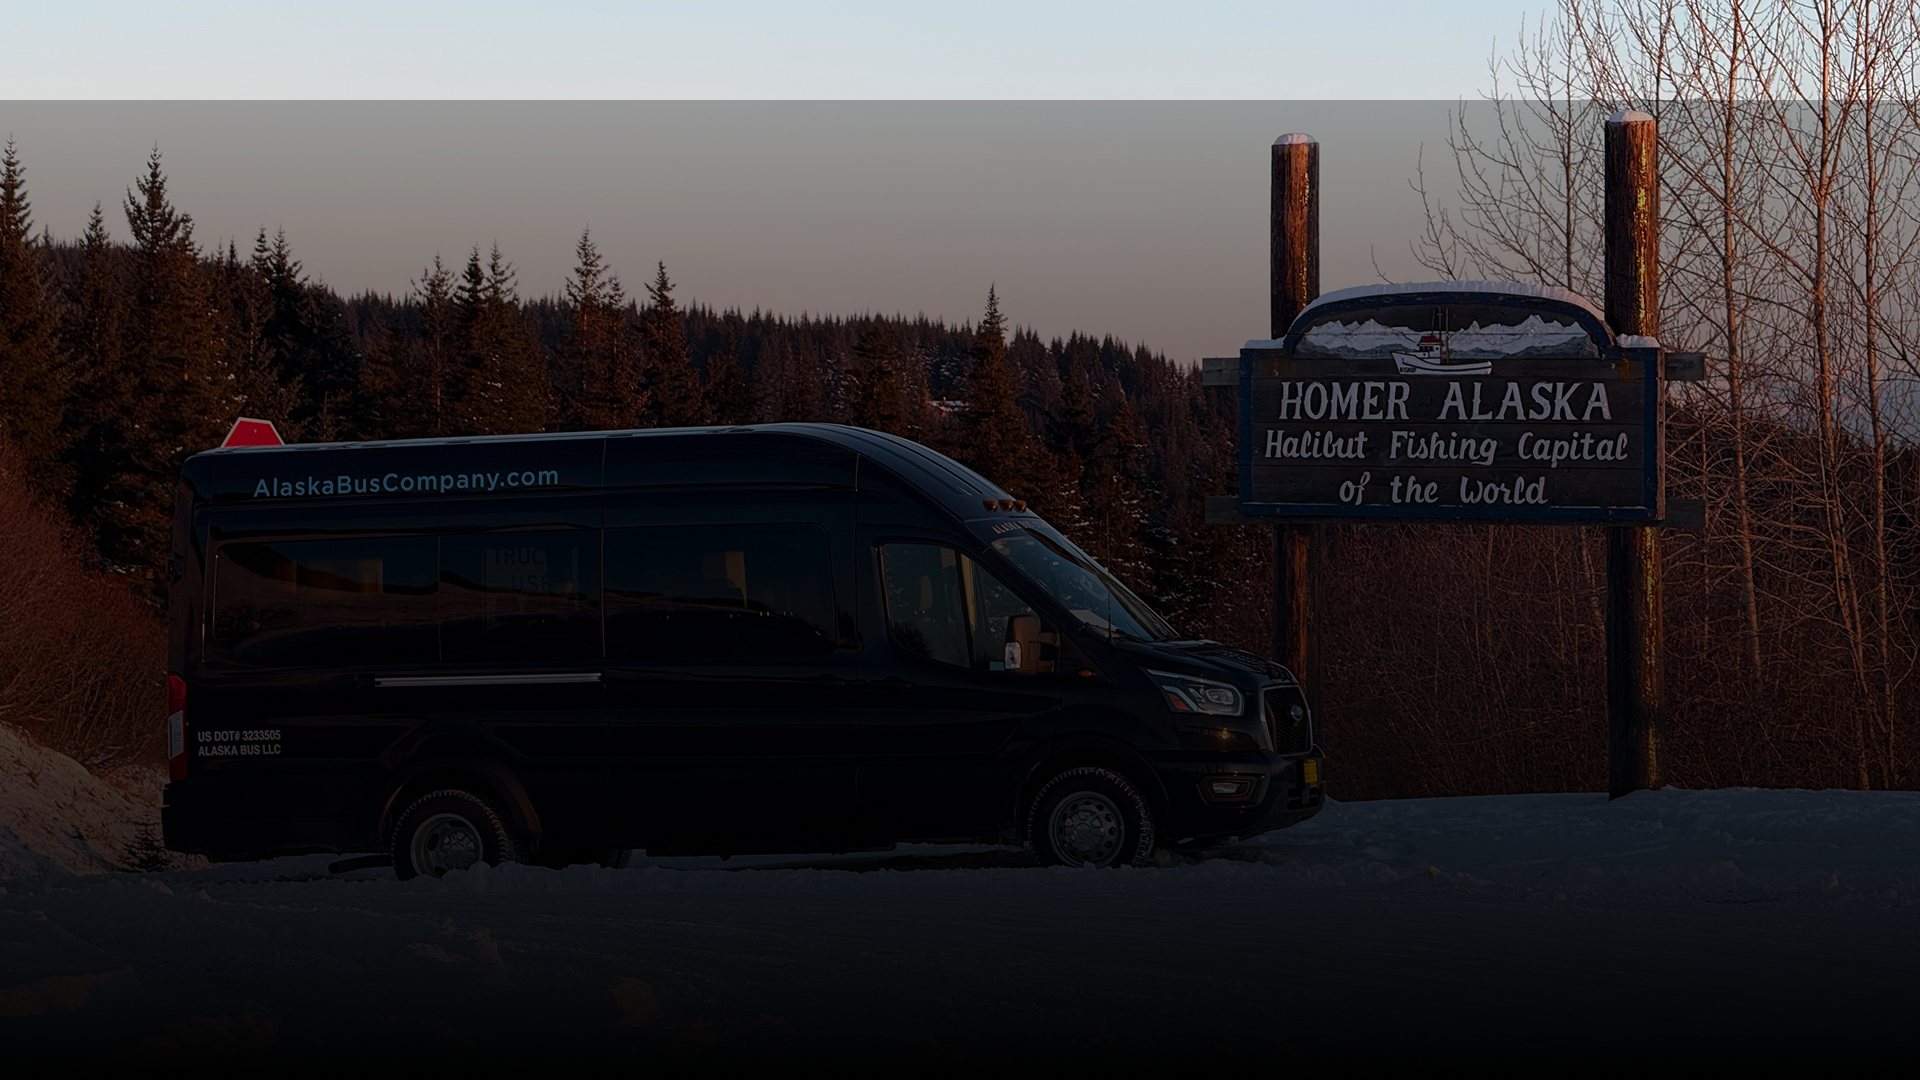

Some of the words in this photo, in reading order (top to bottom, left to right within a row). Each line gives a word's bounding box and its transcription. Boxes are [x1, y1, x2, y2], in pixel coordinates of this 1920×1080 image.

[1279, 380, 1411, 421] HOMER
[1437, 380, 1613, 421] ALASKA
[1265, 429, 1369, 460] Halibut
[1389, 429, 1499, 466] Fishing
[1517, 430, 1629, 468] Capital
[253, 469, 559, 498] AlaskaBusCompany.com
[1338, 471, 1371, 506] of
[1390, 474, 1439, 504] the
[1459, 474, 1549, 505] World
[493, 547, 544, 565] TRUC
[197, 731, 213, 742] US
[214, 730, 241, 742] DOT#
[242, 729, 282, 741] 3233505
[198, 745, 239, 757] ALASKA
[240, 744, 261, 755] BUS
[262, 743, 282, 755] LLC
